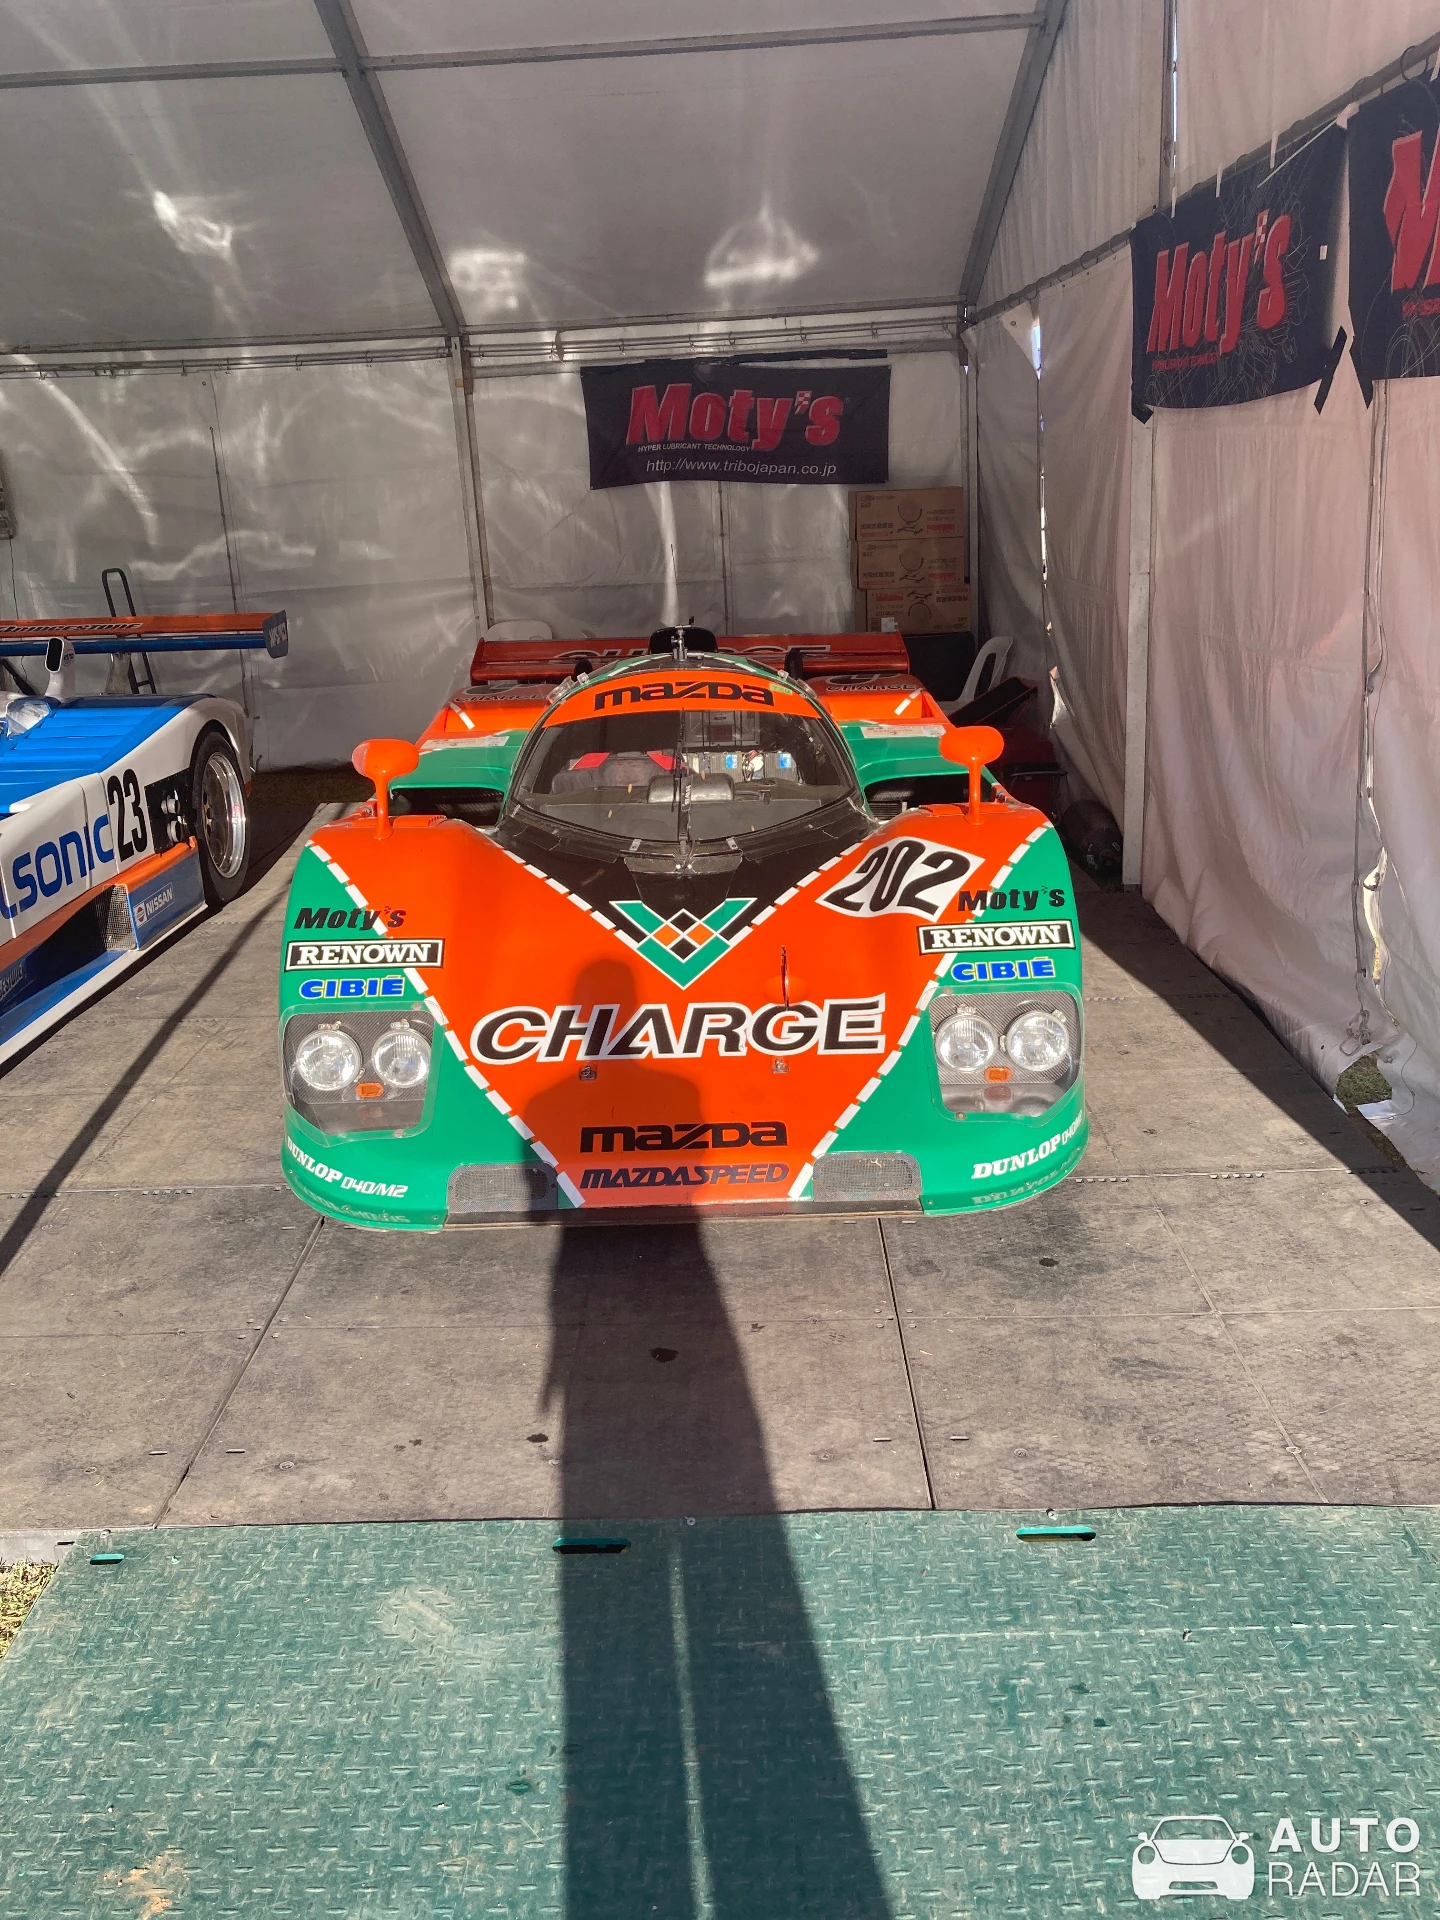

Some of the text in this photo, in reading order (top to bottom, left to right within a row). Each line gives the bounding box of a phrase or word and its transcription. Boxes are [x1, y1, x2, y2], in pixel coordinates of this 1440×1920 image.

[1146, 208, 1292, 356] Moty's
[626, 383, 844, 451] Moty's
[638, 443, 750, 453] HYPER LUBRICANT TECHNOLOGY
[646, 458, 837, 477] http://www.tribojapan.co.jp
[107, 769, 148, 862] 23
[823, 839, 970, 914] 202
[145, 887, 173, 916] NISSAN
[957, 885, 1066, 911] Moty's
[294, 906, 406, 931] Moty's
[930, 925, 1061, 948] RENOWN
[298, 942, 431, 965] RENOWN
[470, 993, 886, 1064] CHARGE
[287, 1136, 343, 1183] DUNLOP
[971, 1134, 1060, 1179] DUNLOP
[580, 1163, 790, 1189] MAZDASPEED
